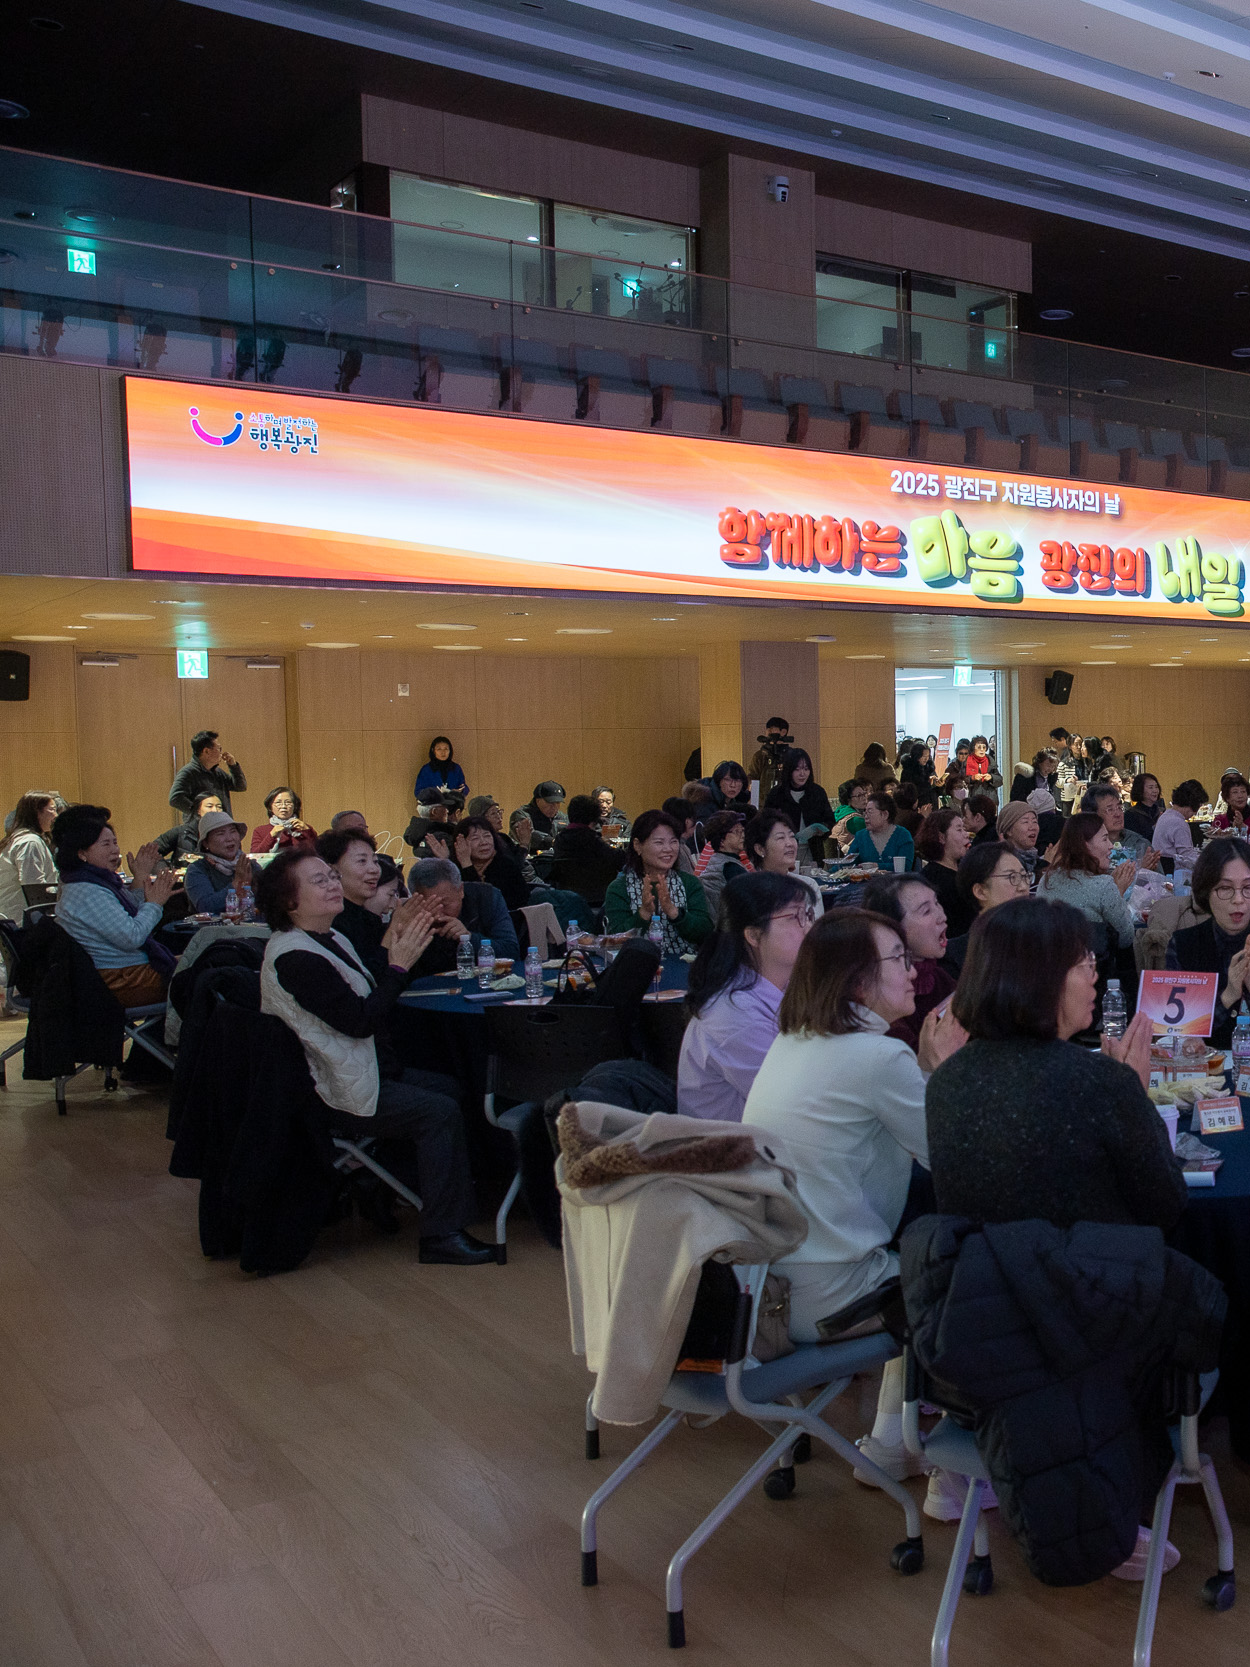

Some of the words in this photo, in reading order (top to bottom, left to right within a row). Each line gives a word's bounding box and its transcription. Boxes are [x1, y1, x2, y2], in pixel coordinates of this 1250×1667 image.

[249, 427, 319, 455] 행복광진
[890, 469, 940, 497] 2025
[944, 475, 998, 502] 광진구
[1001, 481, 1100, 513] 자원봉사자의
[1103, 492, 1121, 515] 날
[717, 506, 902, 573] 함께하는
[909, 509, 1021, 599] 마음
[1039, 540, 1147, 595] 광진의
[1155, 535, 1242, 614] 내일
[1163, 986, 1187, 1025] 5
